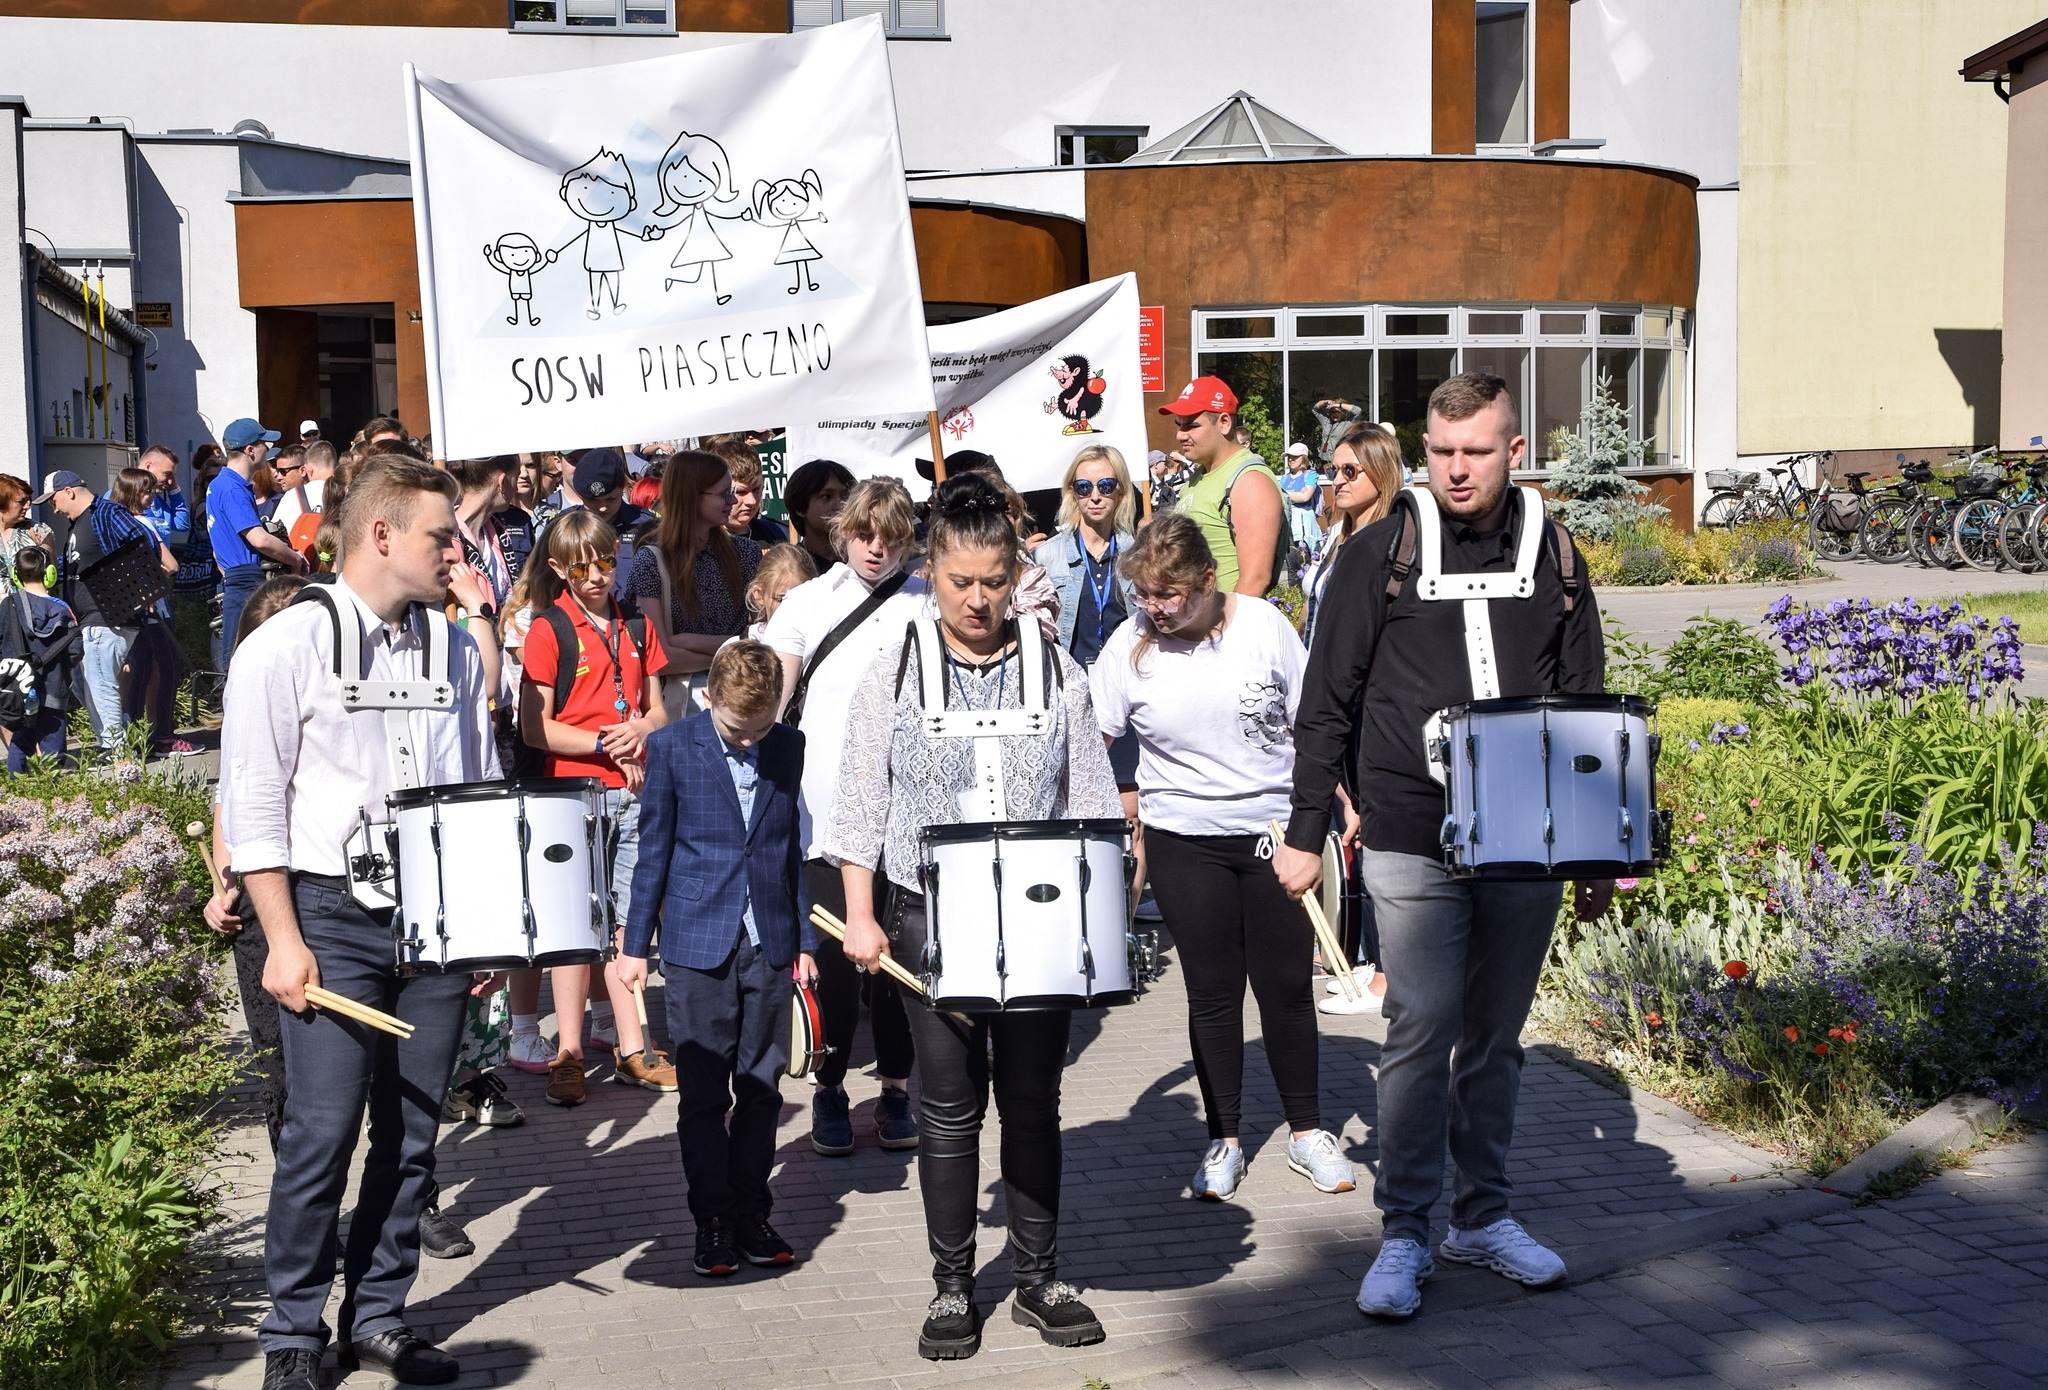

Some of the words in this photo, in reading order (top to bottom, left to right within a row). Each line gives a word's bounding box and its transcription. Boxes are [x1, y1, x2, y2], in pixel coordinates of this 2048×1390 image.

[511, 353, 604, 406] SOSW
[638, 322, 832, 392] PIASECZNO
[931, 356, 951, 368] jeśli
[951, 358, 967, 366] nie
[968, 352, 988, 367] będę
[988, 348, 1012, 364] mógł
[932, 374, 947, 384] ym
